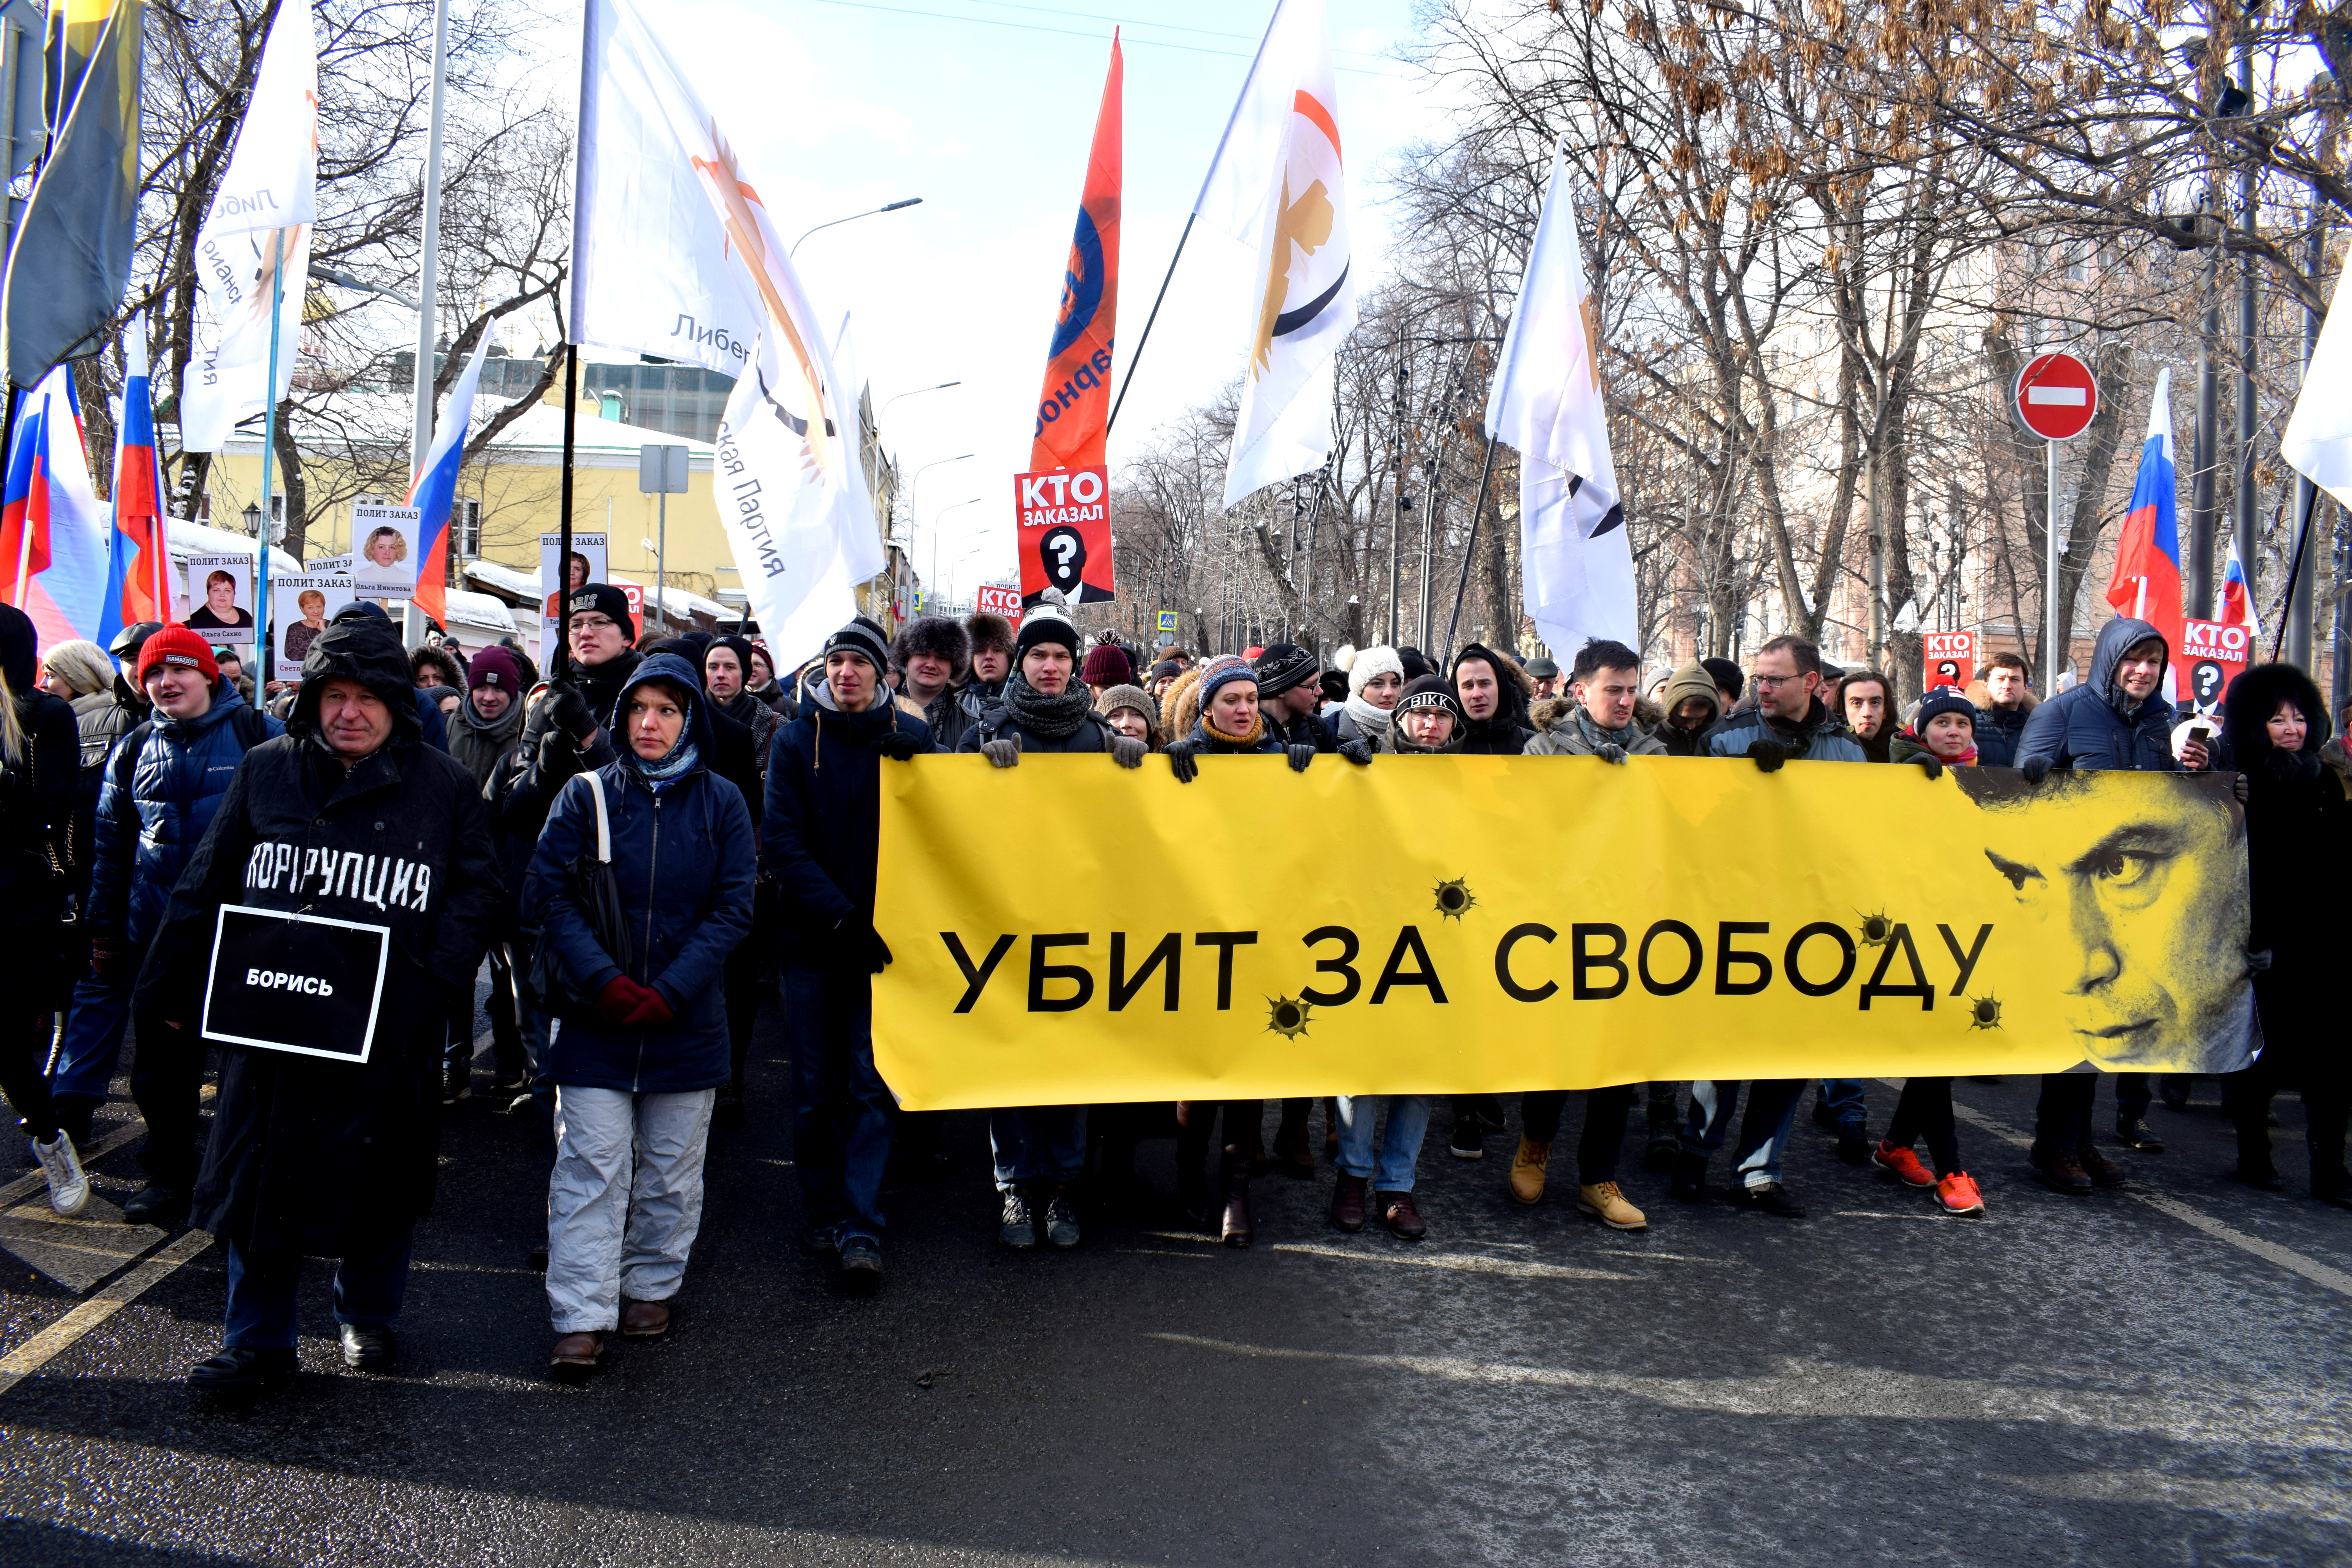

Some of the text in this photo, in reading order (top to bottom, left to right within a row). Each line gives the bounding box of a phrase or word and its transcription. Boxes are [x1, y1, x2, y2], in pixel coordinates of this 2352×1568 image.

[1022, 472, 1103, 508] КТО
[357, 509, 418, 519] ПОЛИТ ЗАКАЗ
[1024, 505, 1103, 526] ЗАКАЗАЛ
[733, 479, 786, 578] Партия
[310, 561, 340, 571] ПОЛИТ
[1049, 534, 1077, 579] ?
[278, 578, 352, 588] ПОЛИТ ЗАКАЗ
[981, 588, 1021, 609] КТО
[981, 605, 1020, 618] ЗАКАЗАЛ
[1928, 634, 1970, 651] КТО
[2184, 622, 2245, 649] КТО
[167, 656, 197, 666] RAMAZZOTTI
[1928, 650, 1970, 659] ЗАКАЗАЛ
[2182, 644, 2243, 662] ЗАКАЗАЛ
[2198, 666, 2219, 696] ?
[1411, 694, 1448, 707] BIKK
[939, 919, 1994, 1014] УБИТ ЗА СВОБОДУ
[246, 968, 333, 996] БОРИСЬ
